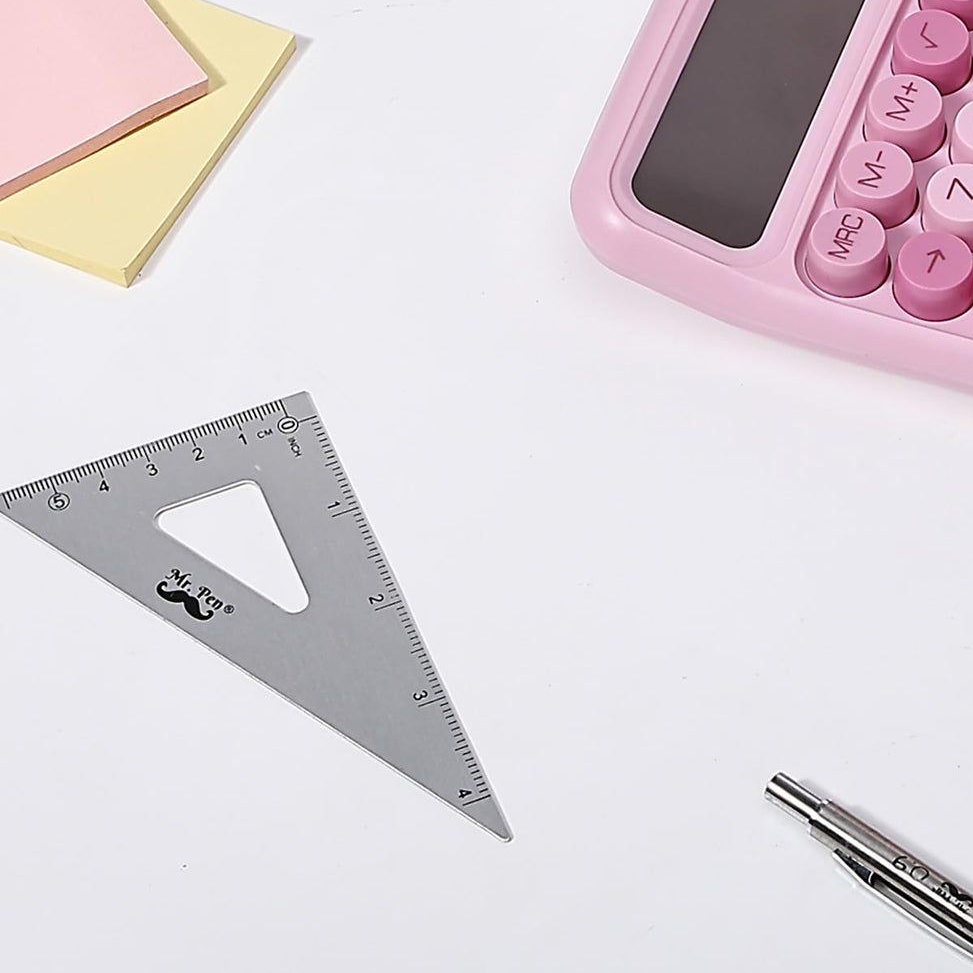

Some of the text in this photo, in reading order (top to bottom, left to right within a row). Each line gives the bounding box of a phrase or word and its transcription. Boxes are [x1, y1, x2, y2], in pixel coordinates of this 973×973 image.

[886, 81, 918, 121] M+
[857, 150, 885, 188] M-
[946, 178, 973, 201] 7
[828, 213, 864, 259] MRC
[239, 433, 248, 446] 1
[256, 428, 274, 439] CM
[288, 437, 302, 458] INCH
[192, 448, 205, 461] 2
[146, 464, 158, 477] 3
[99, 479, 110, 493] 4
[164, 568, 192, 592] Mr.
[369, 593, 385, 605] 2
[413, 690, 428, 701] 3
[458, 789, 472, 799] 4
